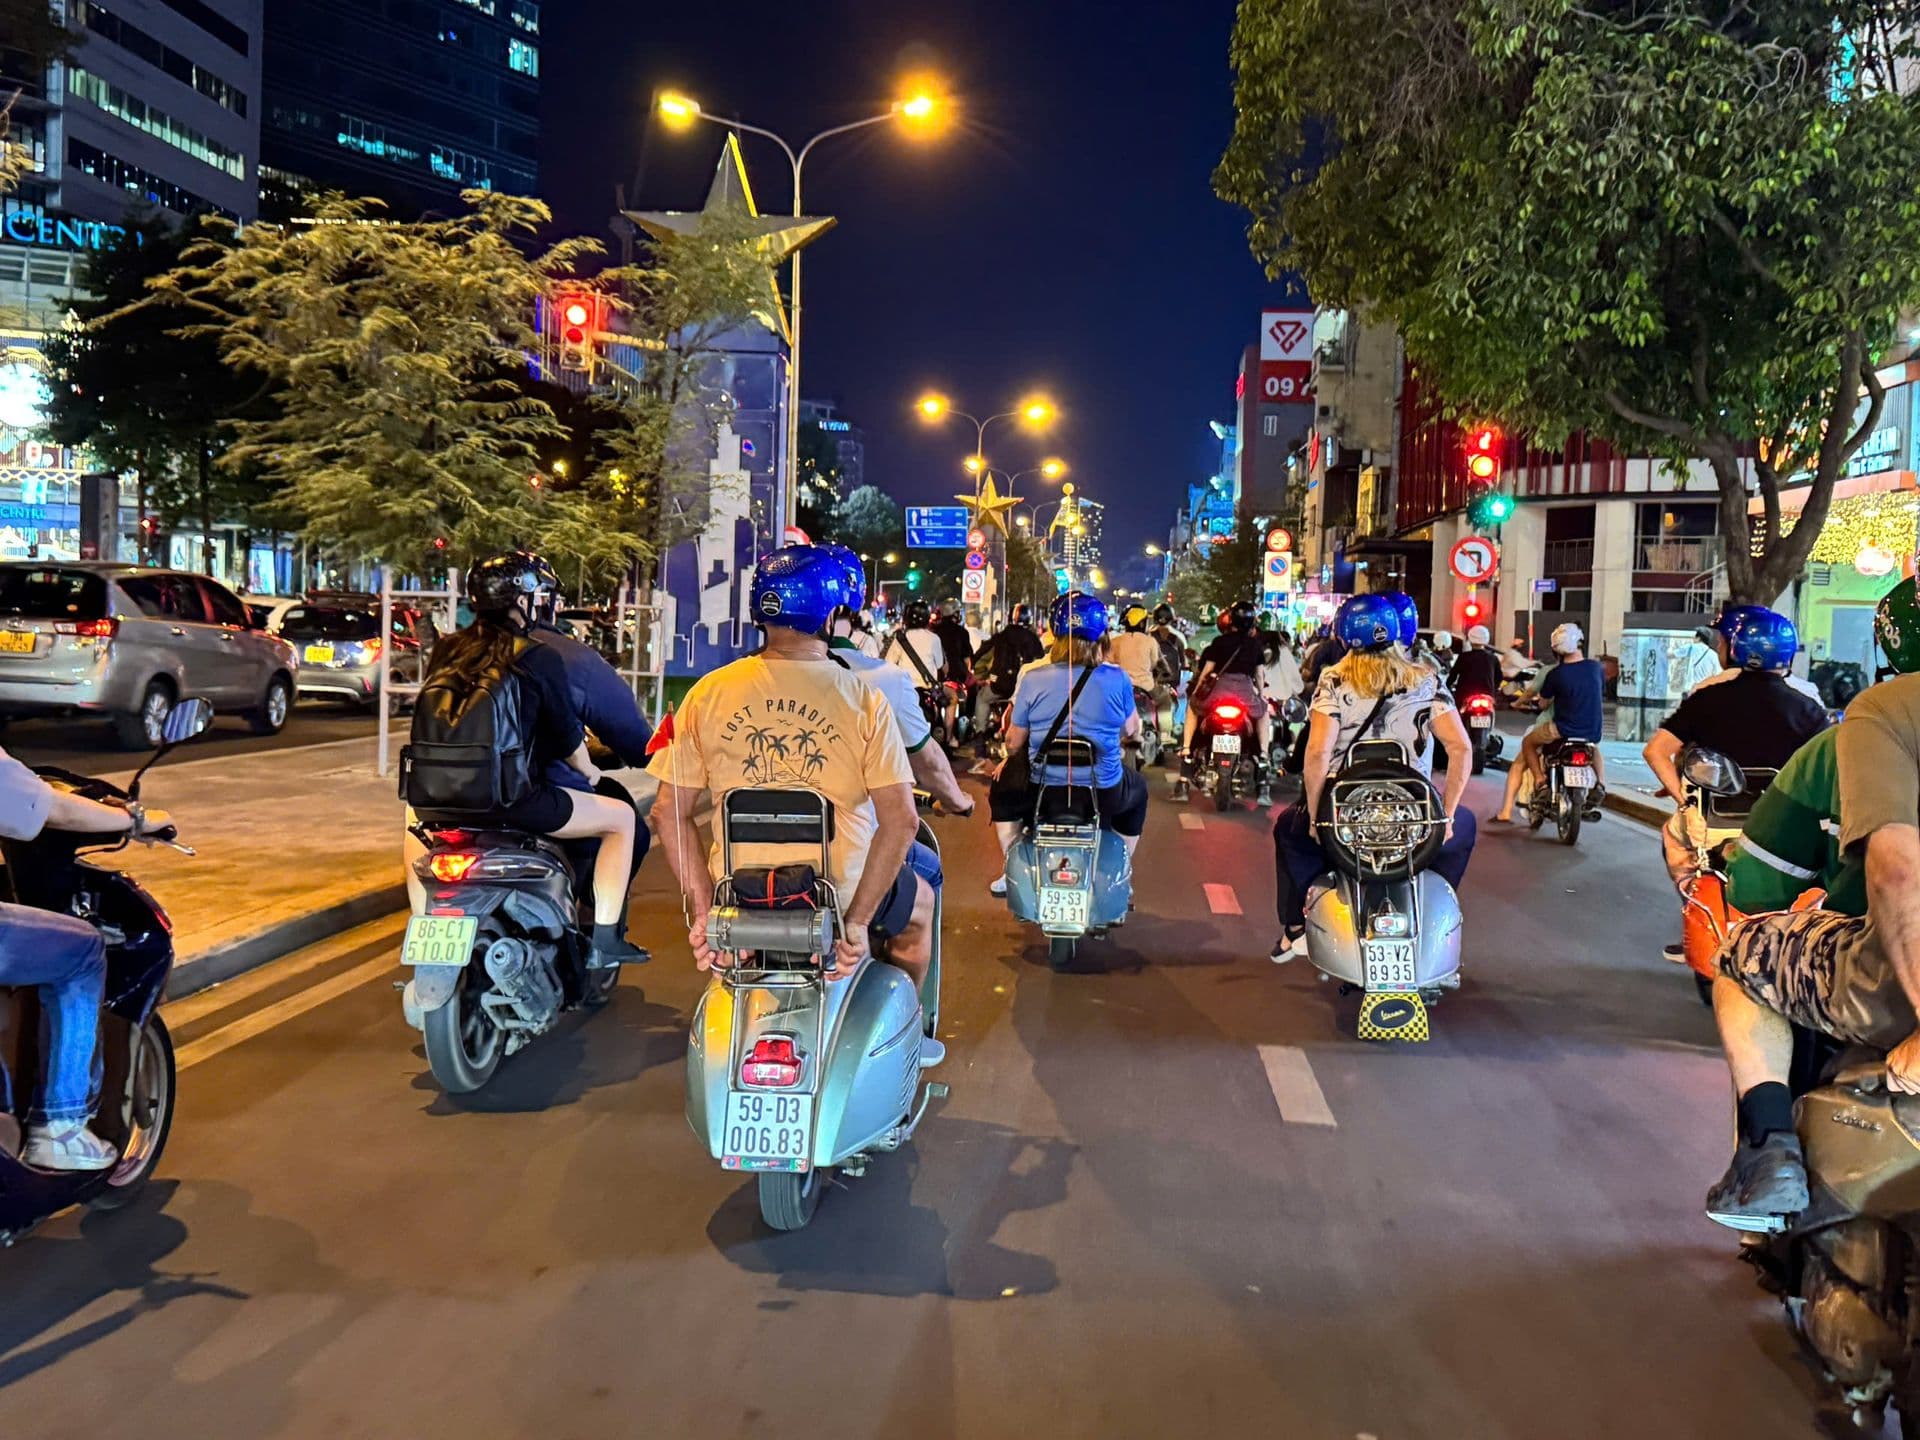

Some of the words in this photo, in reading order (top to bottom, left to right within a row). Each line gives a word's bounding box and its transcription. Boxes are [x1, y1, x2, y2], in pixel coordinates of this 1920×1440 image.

[5, 209, 143, 251] CENT
[721, 705, 752, 742] LOST
[766, 698, 841, 744] PARADISE
[1047, 891, 1081, 905] 59-S3
[1042, 906, 1084, 922] 451.31
[418, 920, 464, 939] 86-C1
[407, 941, 467, 961] 510.01
[1368, 945, 1411, 962] 53-V2
[1369, 964, 1412, 981] 8935
[739, 1095, 800, 1123] 59-D3
[730, 1126, 804, 1155] 006.83
